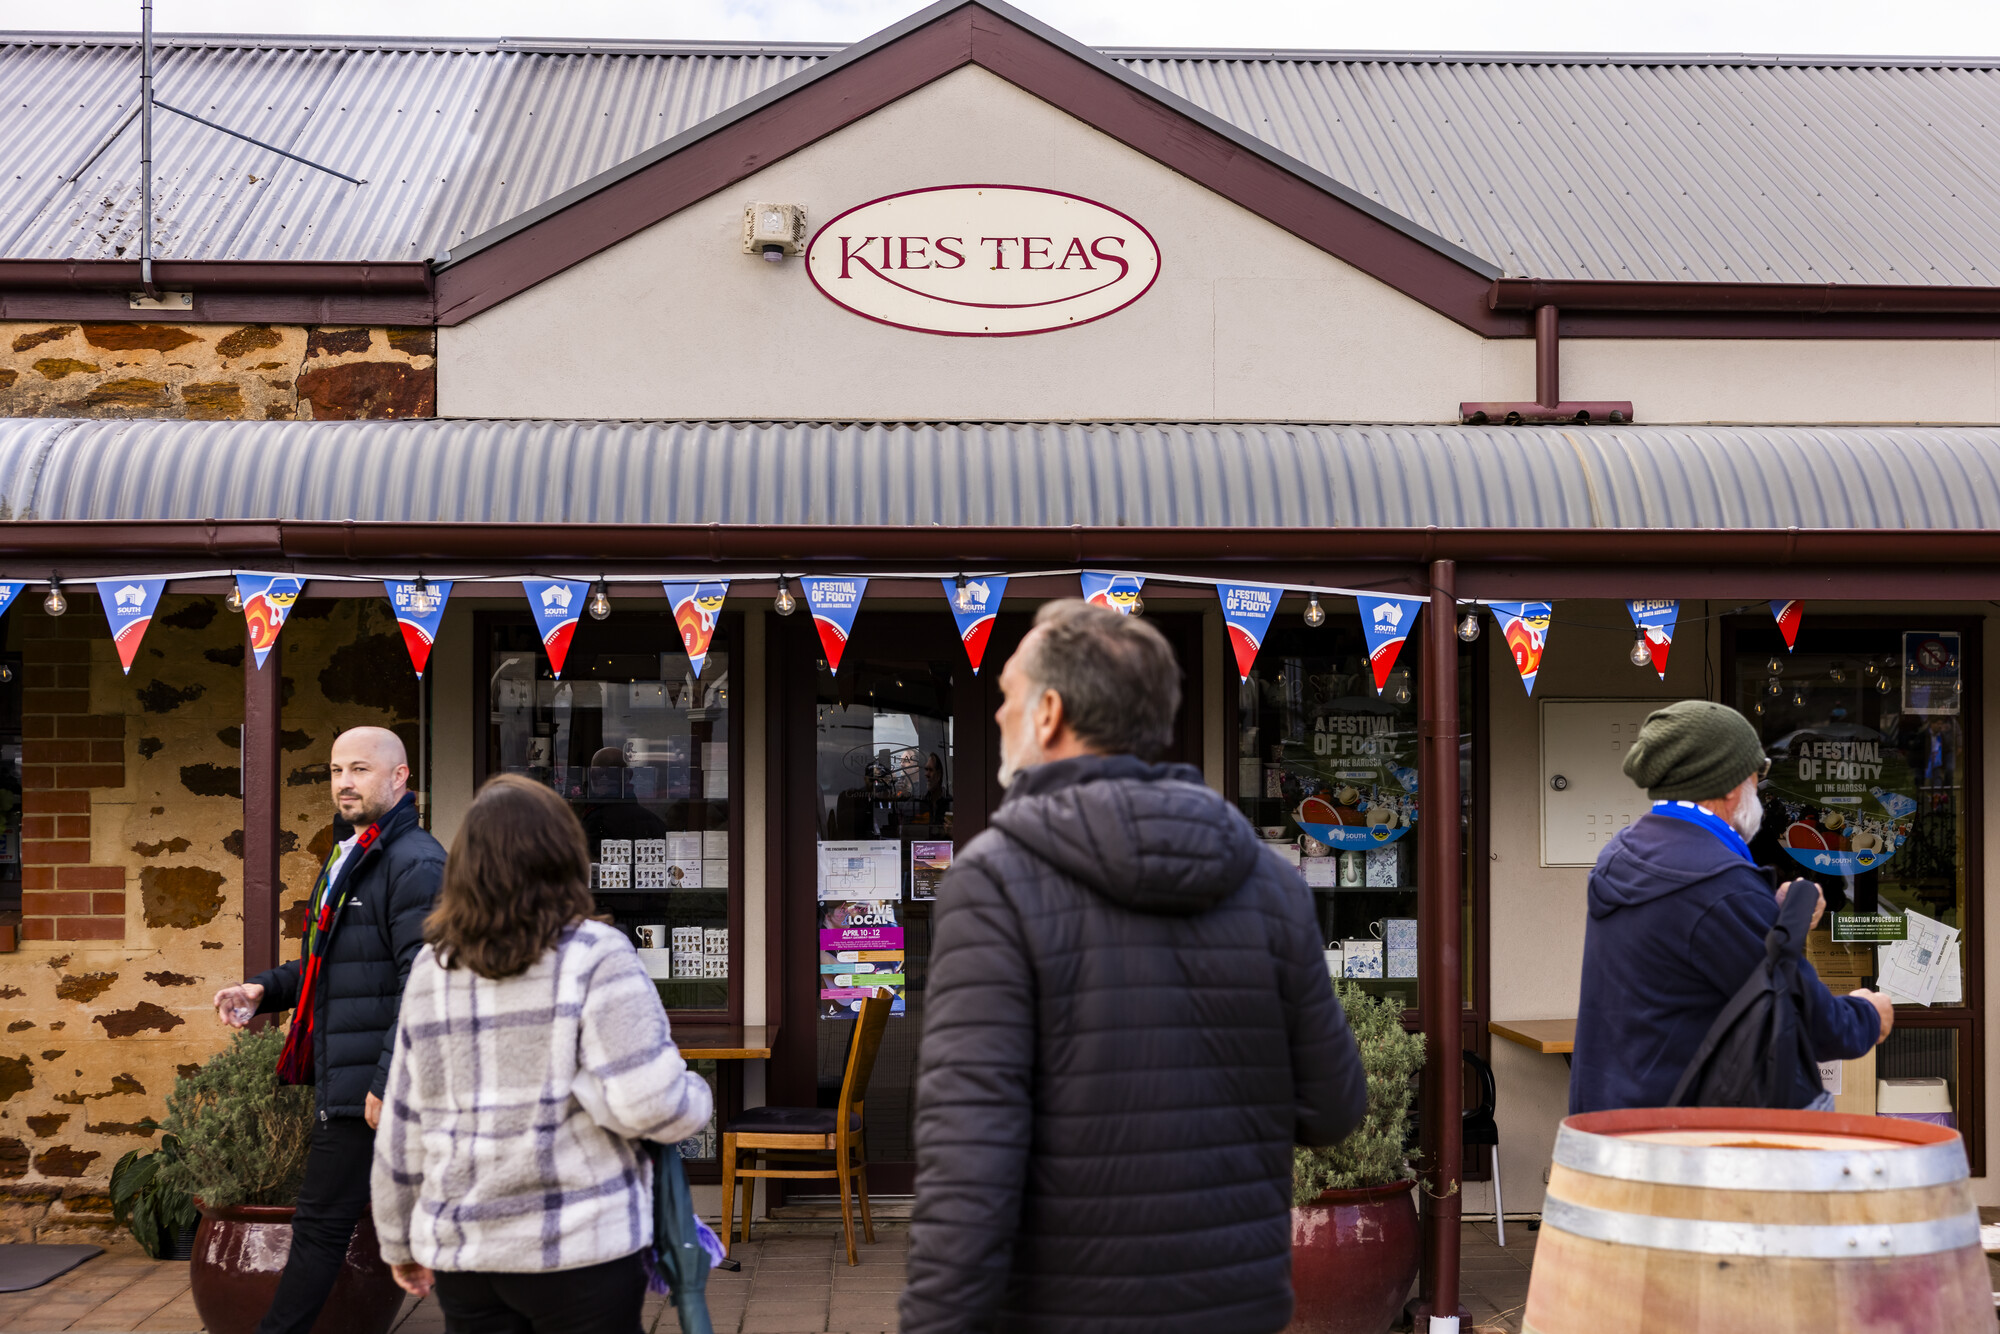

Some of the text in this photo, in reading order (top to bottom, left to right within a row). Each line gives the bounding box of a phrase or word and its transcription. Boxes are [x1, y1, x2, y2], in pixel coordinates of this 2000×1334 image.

[838, 236, 1129, 282] KIES TEAS
[396, 584, 403, 593] A
[812, 582, 857, 593] A FESTIVAL
[396, 593, 409, 605] OF
[811, 590, 857, 602] OF FOOTY
[1227, 588, 1272, 604] A FESTIVAL
[1226, 597, 1271, 612] OF FOOTY
[1633, 599, 1675, 613] OF FOOTY
[1374, 624, 1397, 633] SOUTH
[1315, 716, 1399, 738] A FESTIVAL
[1313, 733, 1398, 756] OF FOOTY
[1799, 741, 1883, 764] A FESTIVAL
[1330, 759, 1383, 767] IN THE BAROSSA
[1798, 758, 1882, 781] OF FOOTY
[1815, 783, 1867, 792] IN THE BAROSSA
[867, 904, 892, 914] LIVE
[848, 914, 888, 925] LOCAL
[842, 929, 859, 937] APRIL
